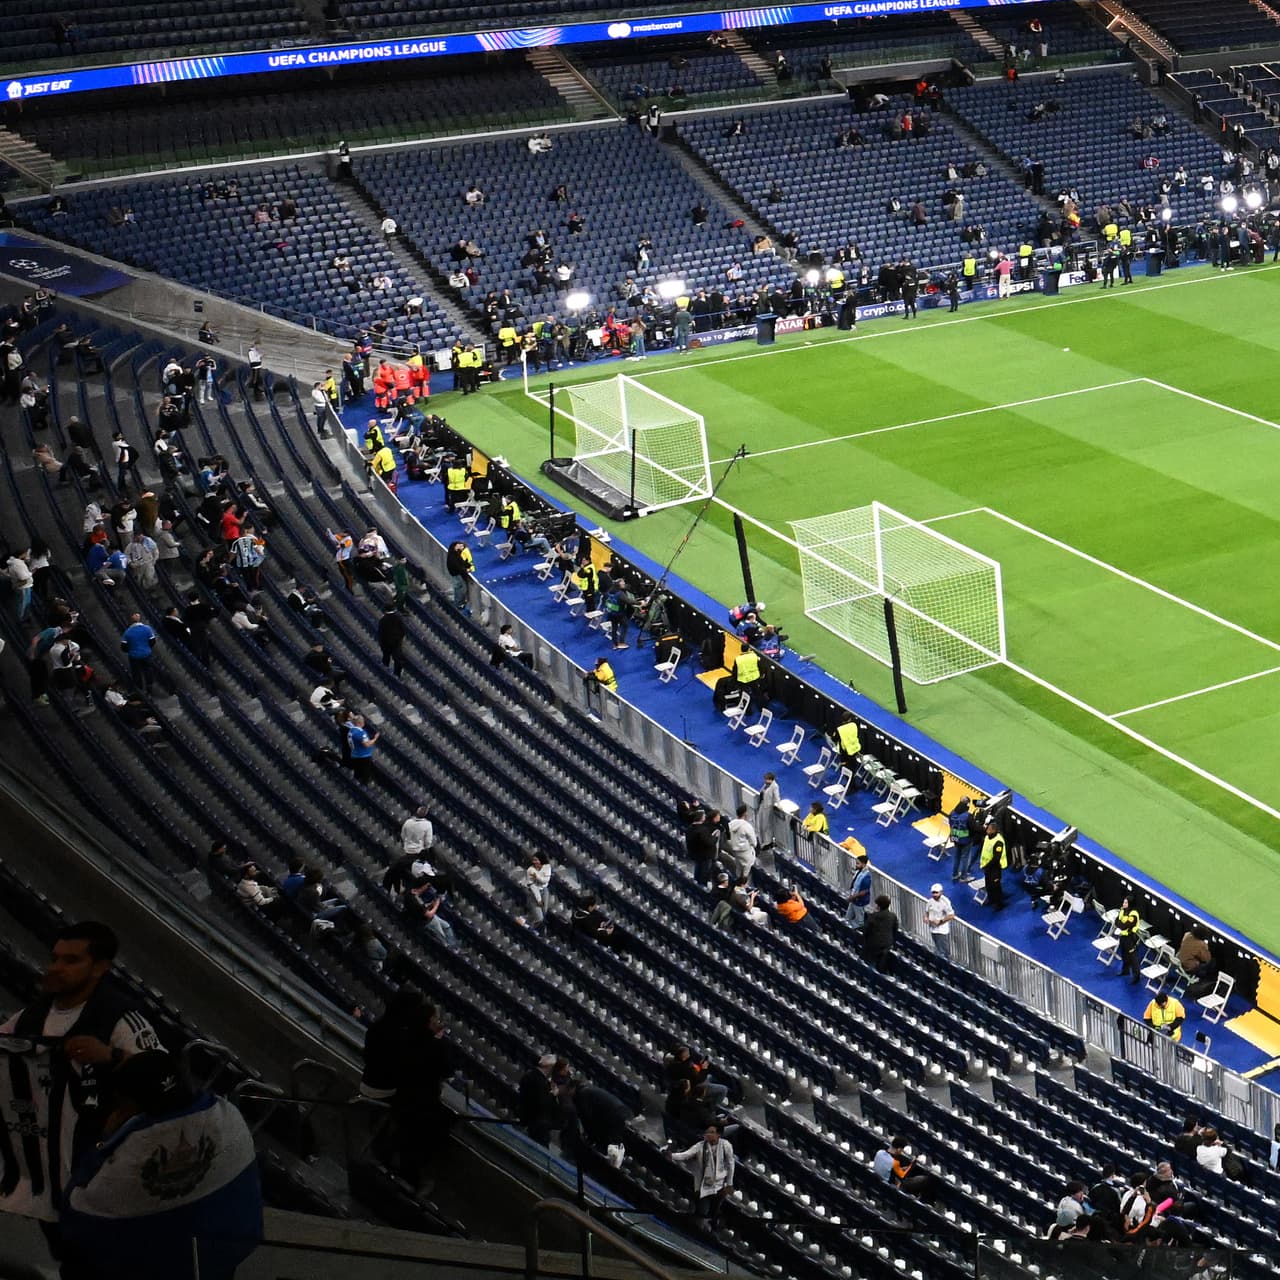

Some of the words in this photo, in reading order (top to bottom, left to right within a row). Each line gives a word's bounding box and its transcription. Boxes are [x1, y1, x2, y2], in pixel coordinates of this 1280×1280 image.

[824, 6, 852, 17] UEFA
[854, 0, 919, 14] CHAMPIONS
[268, 54, 306, 67] UEFA
[308, 45, 392, 63] CHAMPIONS
[395, 40, 447, 55] LEAGUE
[24, 83, 50, 96] JUST
[50, 79, 72, 91] EAT
